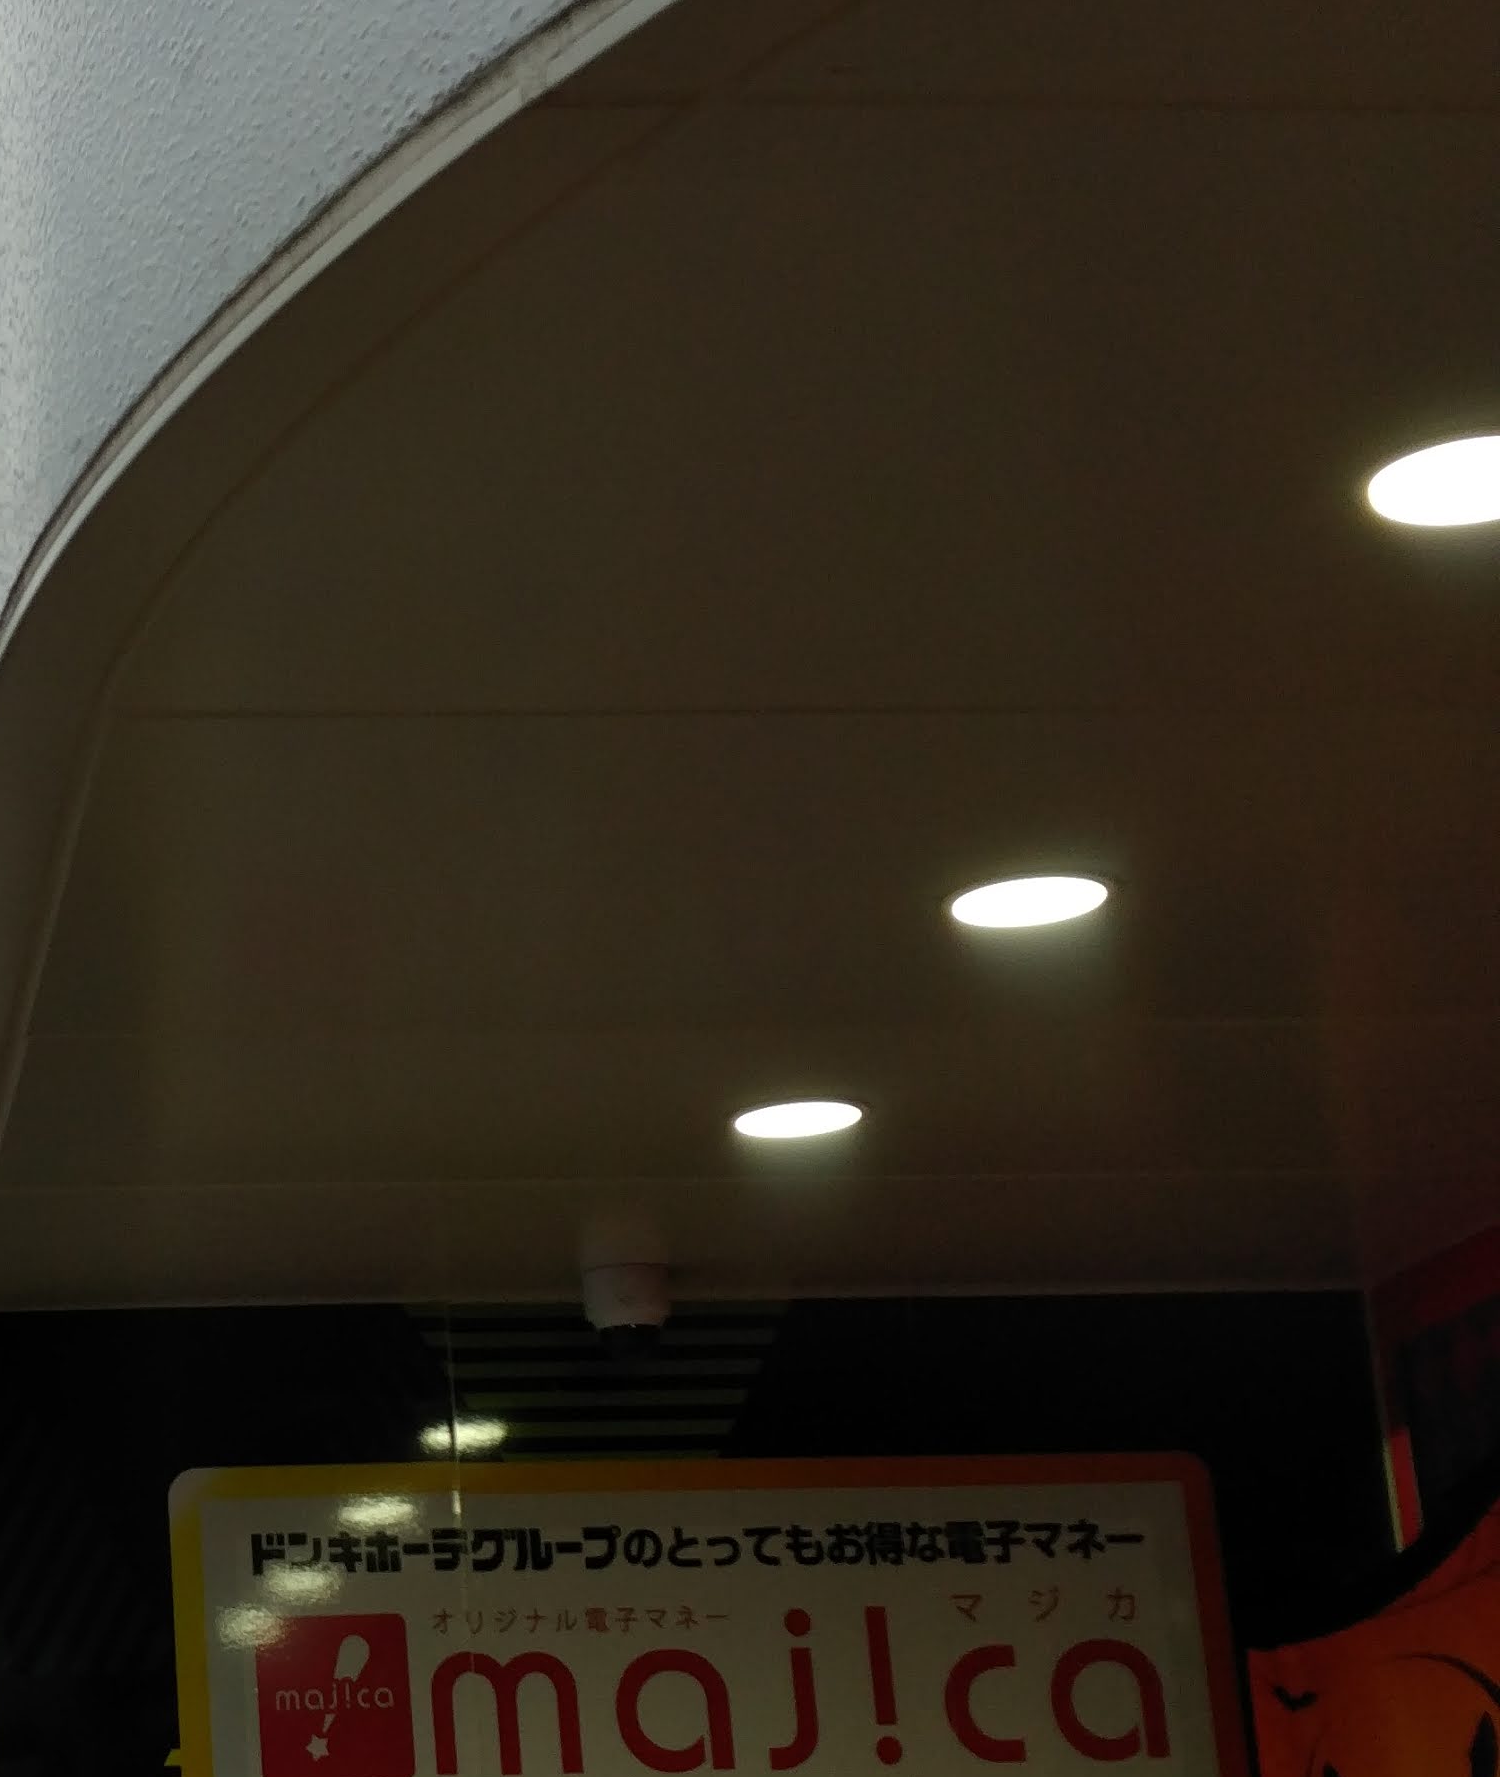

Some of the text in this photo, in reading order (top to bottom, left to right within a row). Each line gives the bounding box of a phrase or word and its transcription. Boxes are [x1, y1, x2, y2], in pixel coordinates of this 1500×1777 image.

[432, 1605, 731, 1635] オリジナル電子マネー
